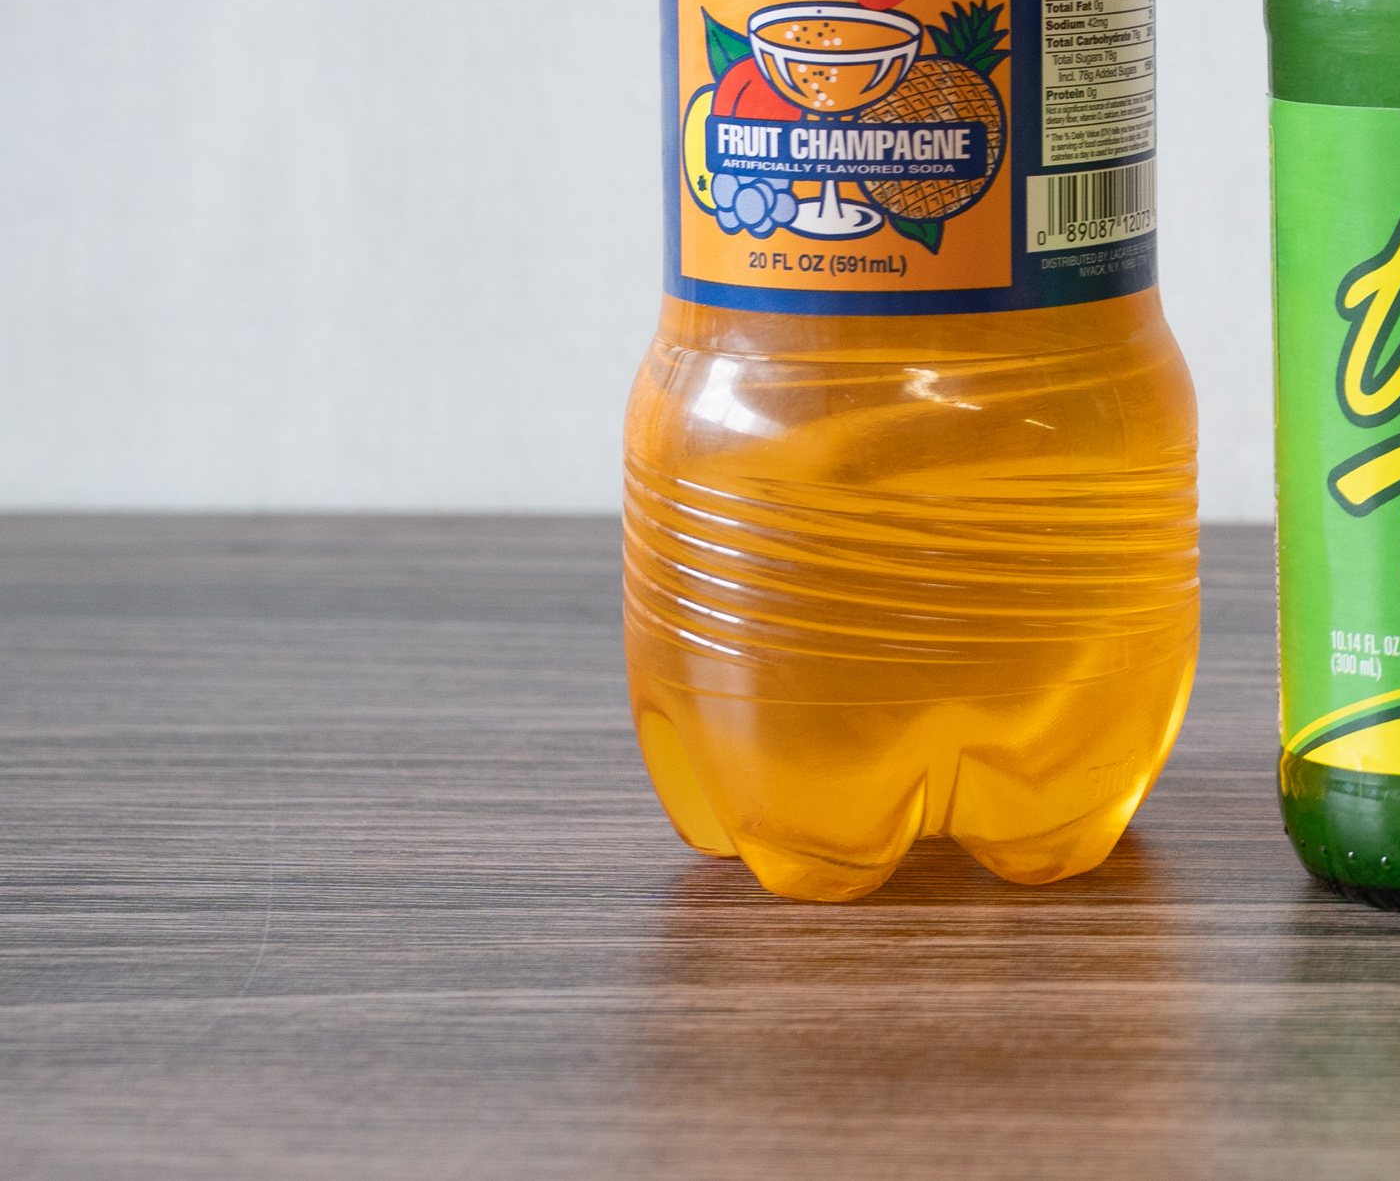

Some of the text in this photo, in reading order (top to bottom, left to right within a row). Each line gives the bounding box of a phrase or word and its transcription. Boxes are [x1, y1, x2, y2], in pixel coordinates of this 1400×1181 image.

[1045, 0, 1103, 14] Total Fat 0g
[1045, 18, 1108, 31] Sodium 42mg
[1045, 37, 1073, 48] Total
[1076, 31, 1131, 46] Carbohydrate
[1052, 53, 1073, 65] Total
[1075, 52, 1103, 65] Sugars
[1078, 70, 1094, 82] 78g
[1095, 66, 1118, 79] Added
[1046, 87, 1097, 100] Protein 0g
[717, 123, 972, 161] FRUIT CHAMPAGNE
[722, 158, 957, 175] ARTIFICIALLY FLAVORED SODA
[1036, 230, 1046, 246] 0
[1066, 217, 1116, 242] 89087
[749, 251, 908, 278] 20 FL OZ (591mL)
[1330, 629, 1362, 653] 10.14
[1330, 651, 1383, 682] (300 mL)
